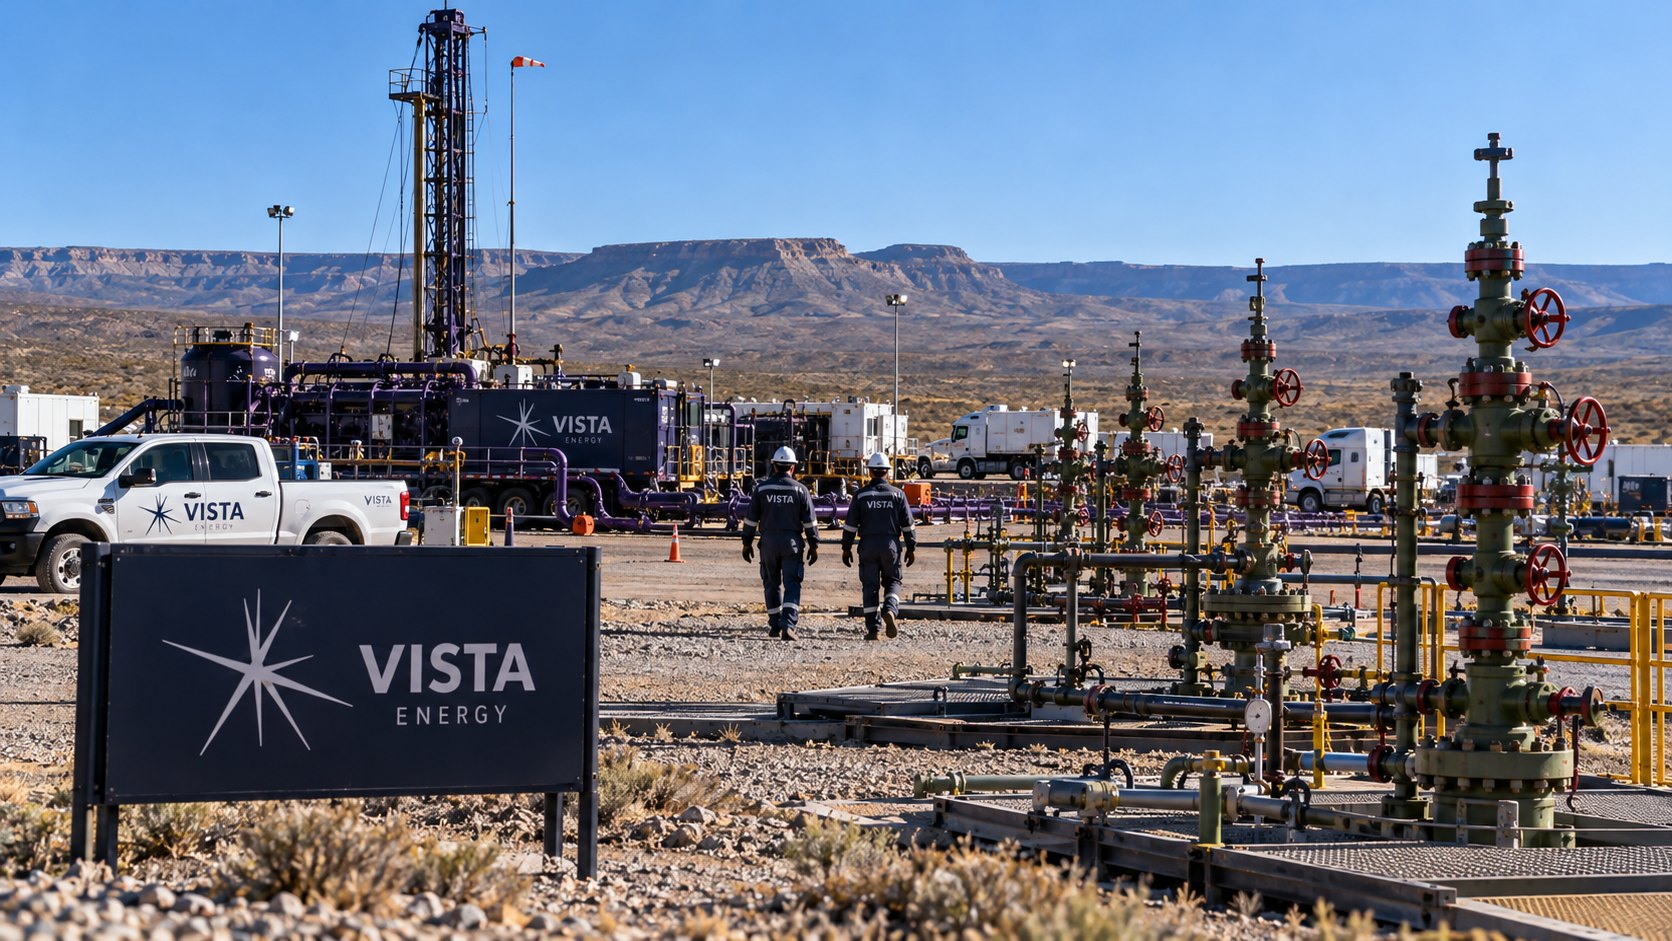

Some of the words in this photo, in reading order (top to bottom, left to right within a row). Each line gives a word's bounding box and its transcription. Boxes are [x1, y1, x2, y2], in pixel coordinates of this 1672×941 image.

[552, 415, 613, 434] VISTA
[565, 436, 602, 444] ENERGY
[364, 495, 392, 506] VISTA
[766, 494, 794, 504] VISTA
[866, 500, 894, 509] VISTA
[184, 502, 244, 521] VISTA
[359, 642, 536, 694] VISTA
[396, 704, 507, 726] ENERGY
